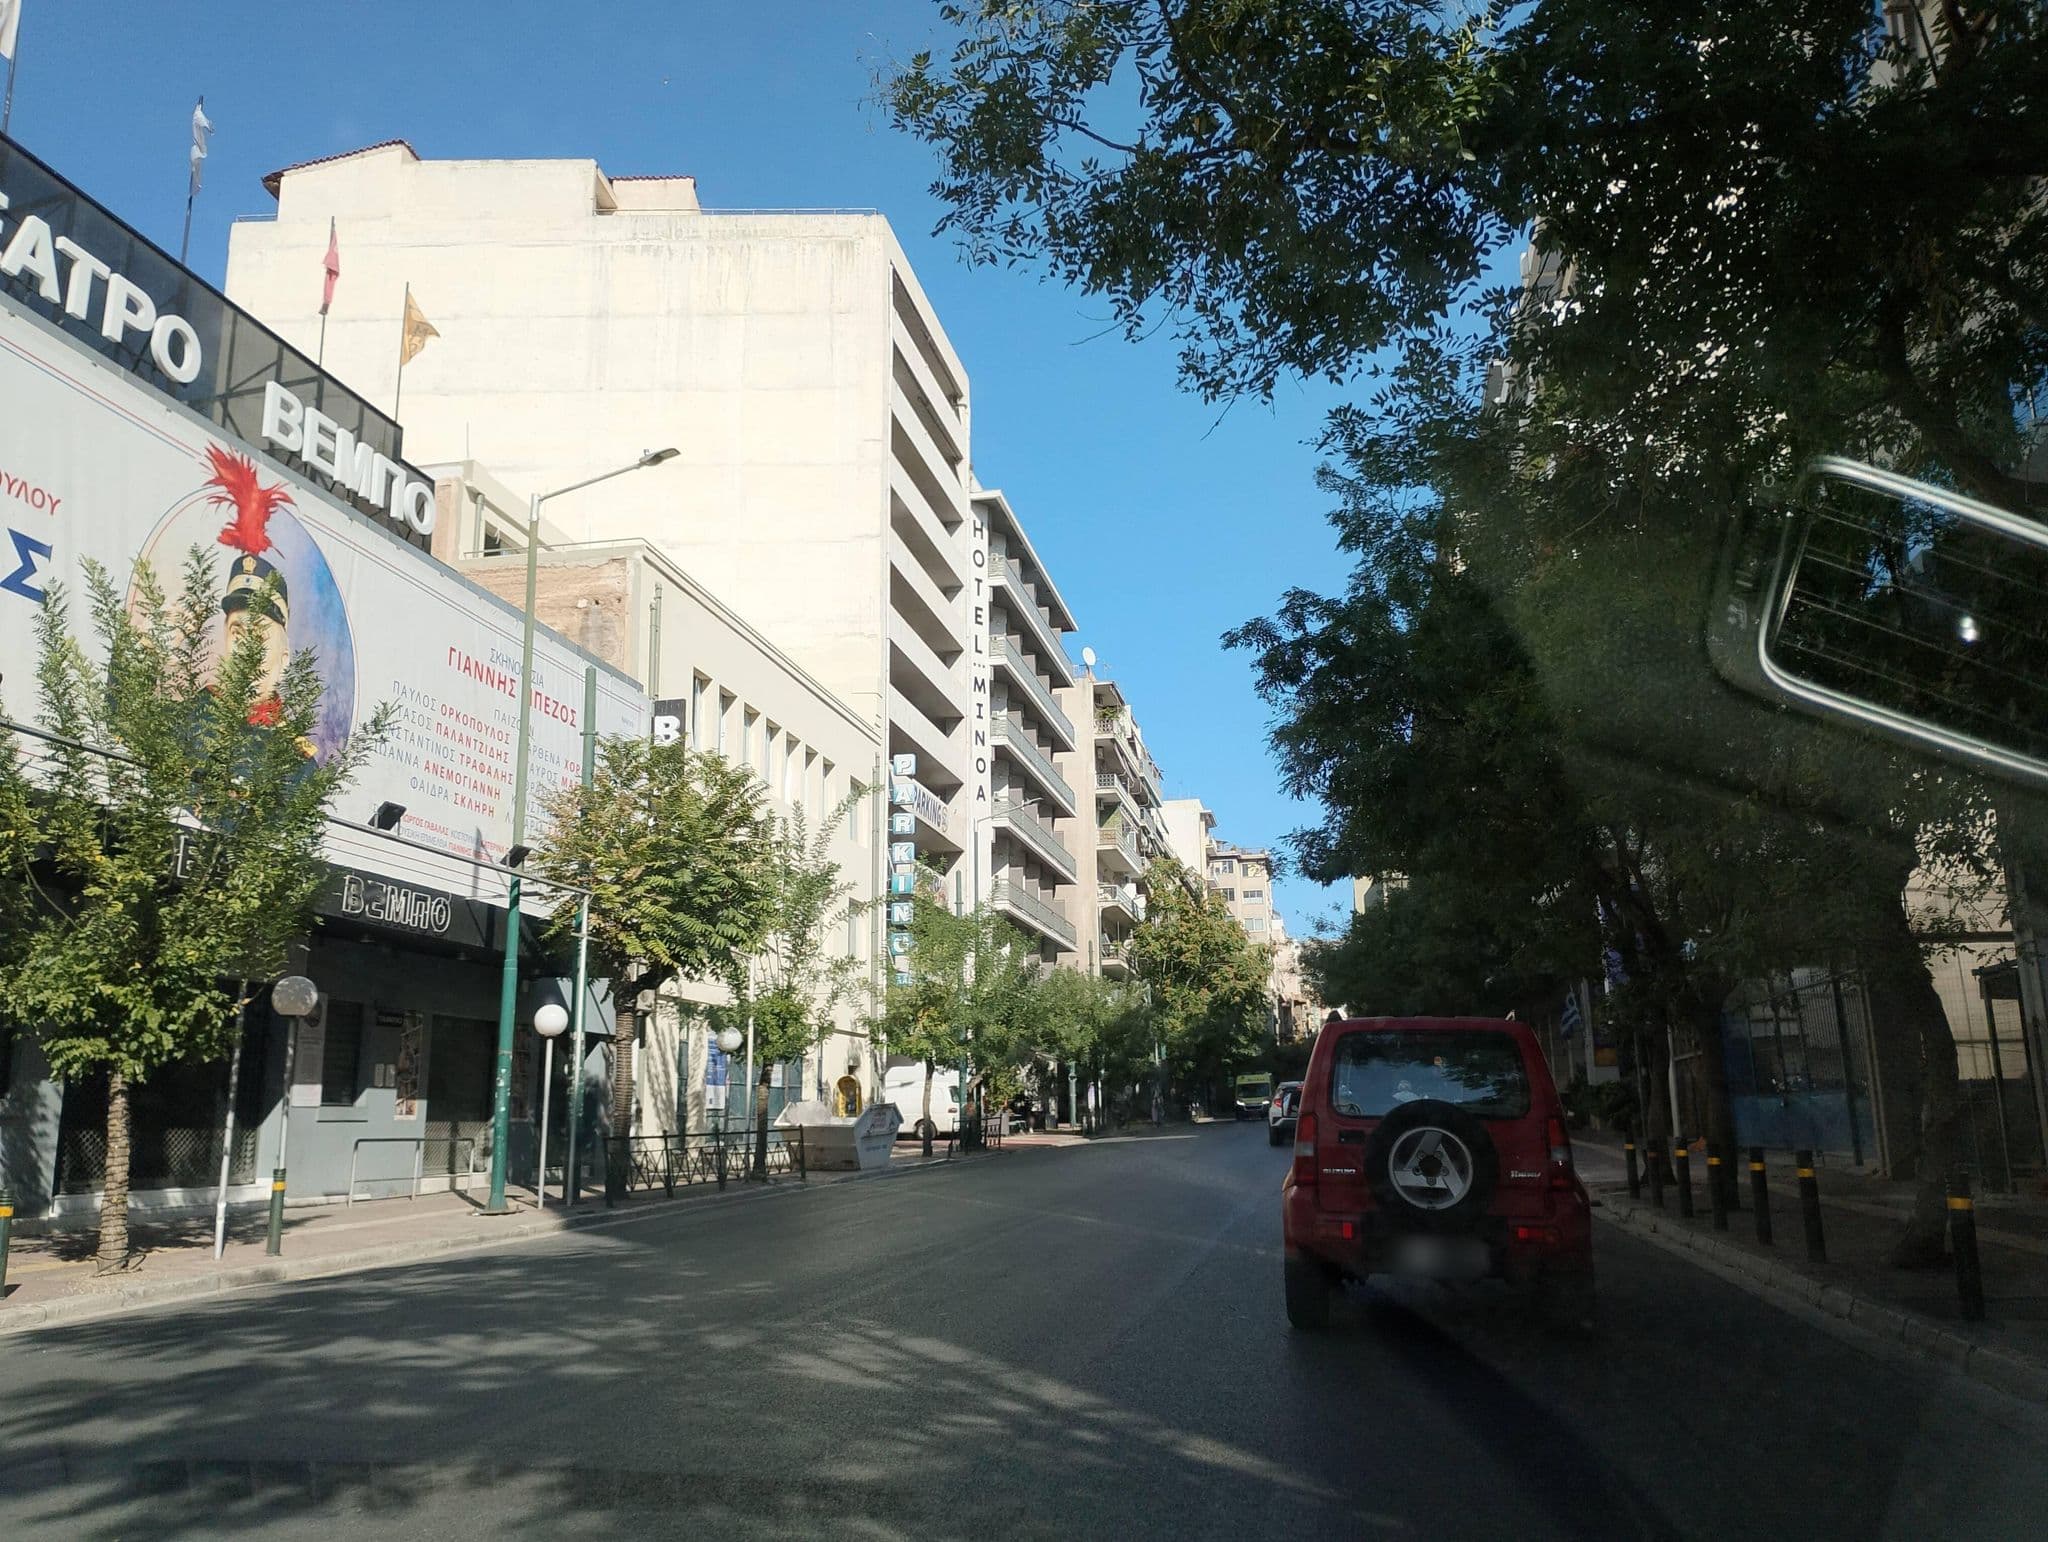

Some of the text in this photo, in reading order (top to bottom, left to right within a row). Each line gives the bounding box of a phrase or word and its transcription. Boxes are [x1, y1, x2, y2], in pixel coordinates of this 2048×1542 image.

[0, 191, 436, 536] ΑΤΡΟ ΒΕΜΠΟ
[0, 469, 62, 516] ΥΛΟΥ
[448, 646, 517, 699] ΓΙΑΝΝΗΣ
[489, 647, 545, 689] ΣΚΗΝΟΣΙΑ
[973, 519, 987, 802] HOTEL MINOA
[392, 680, 511, 745] ΠΑΥΛΟΣ ΟΡΚΟΠΟΥΛΟΣ
[436, 722, 510, 764] ΠΑΛΑΝΤΖΙΔΗΣ
[424, 759, 501, 801] ΑΝΕΜΟΓΙΑΝΝΗ
[459, 753, 514, 786] ΤΡΑΦΑΛΗΣ
[410, 776, 449, 802] ΦΑΙΔΡΑ
[453, 792, 495, 819] ΣΚΛΗΡΗ
[892, 755, 915, 954] PARKING
[342, 874, 452, 933] ΒΕΜΠΟ
